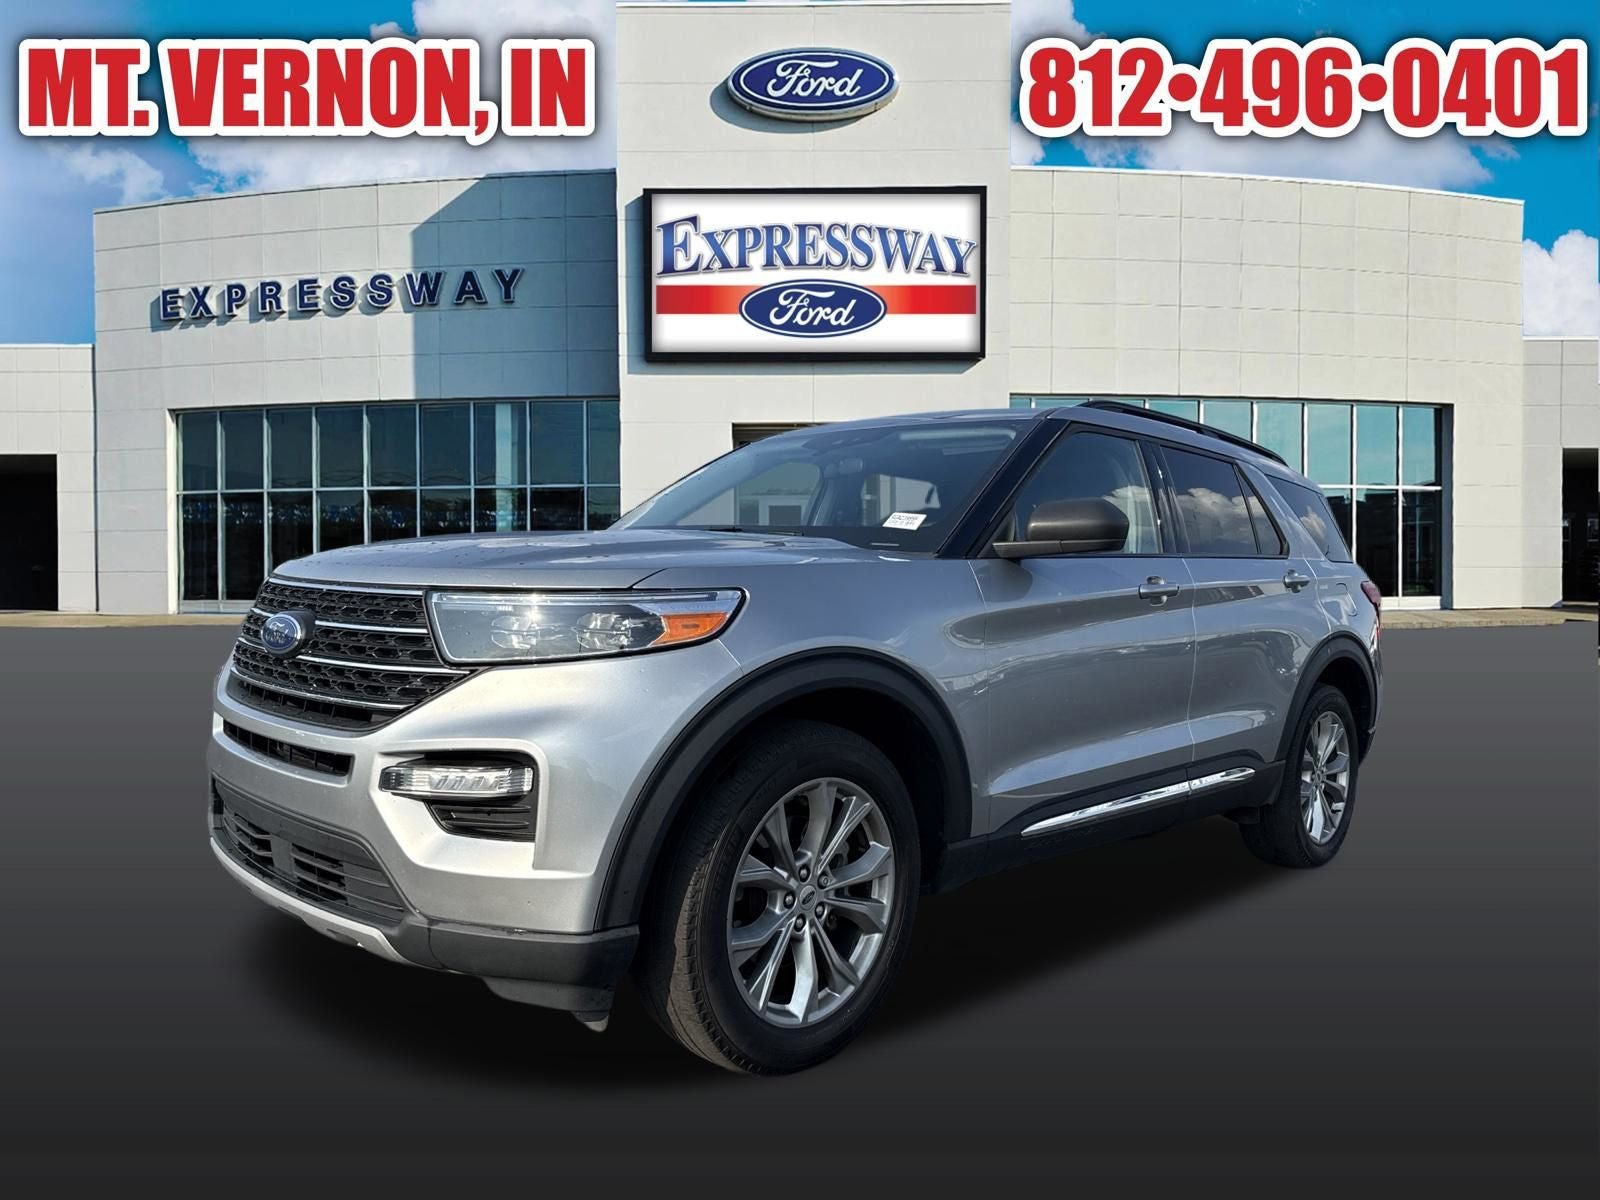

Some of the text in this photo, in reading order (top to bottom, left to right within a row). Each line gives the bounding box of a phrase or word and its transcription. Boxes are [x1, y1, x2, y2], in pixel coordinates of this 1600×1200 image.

[766, 59, 864, 97] Ford
[655, 214, 977, 278] EXPRESSWAY
[159, 267, 524, 321] EXPRESSWAY
[769, 288, 857, 326] Ford
